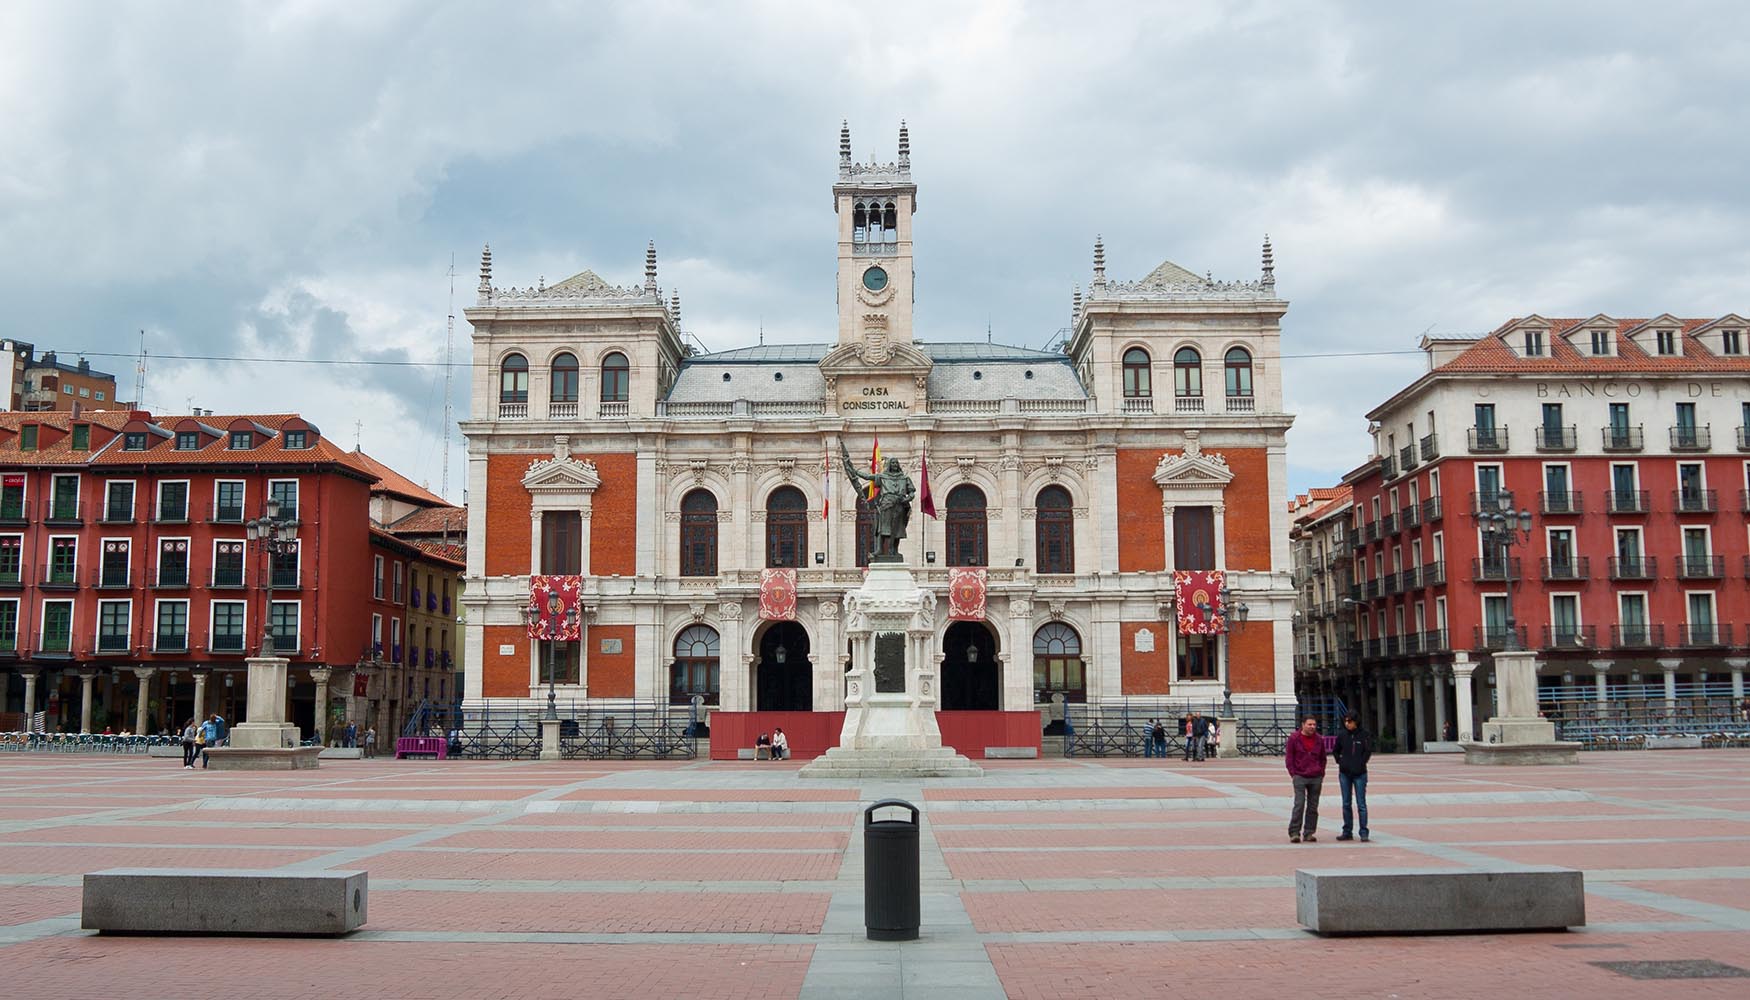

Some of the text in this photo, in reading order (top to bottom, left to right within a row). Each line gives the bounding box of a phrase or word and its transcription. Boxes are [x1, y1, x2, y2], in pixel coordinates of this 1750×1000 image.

[862, 387, 889, 396] CASA
[1536, 382, 1723, 398] BANCO DE
[842, 401, 910, 410] CONSISTORIAL
